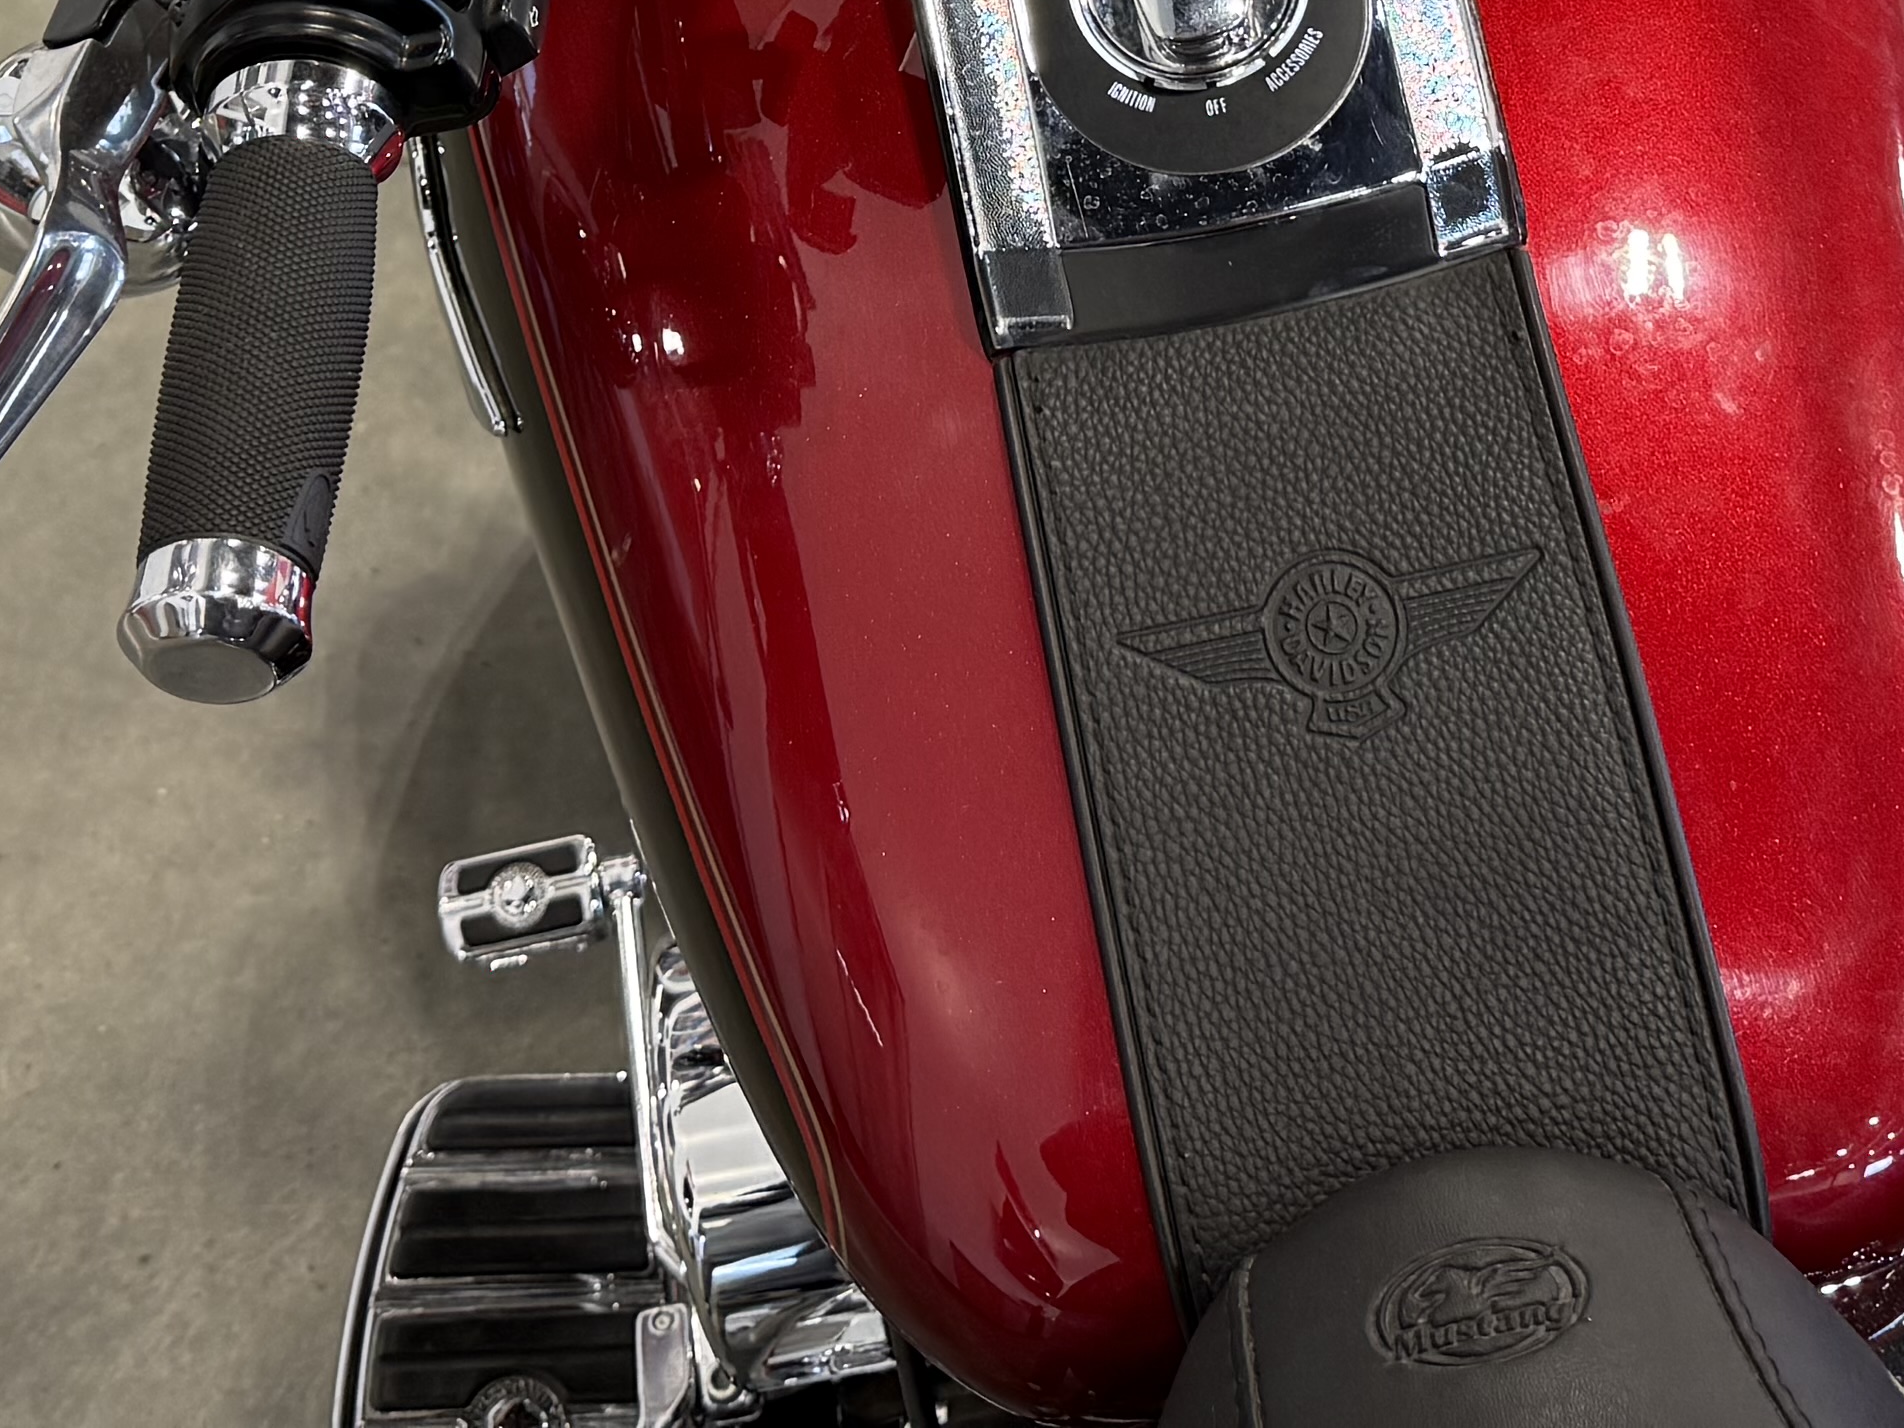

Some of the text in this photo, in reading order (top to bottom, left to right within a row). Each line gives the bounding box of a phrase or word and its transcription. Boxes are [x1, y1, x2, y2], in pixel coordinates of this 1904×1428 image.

[1264, 27, 1324, 92] ACCESSORIES
[1107, 81, 1157, 113] IGNITION
[1205, 97, 1227, 117] OFF
[1278, 568, 1379, 622] HARLEY
[1281, 618, 1389, 687] DAVIDSON
[1395, 1301, 1573, 1361] Mustang
